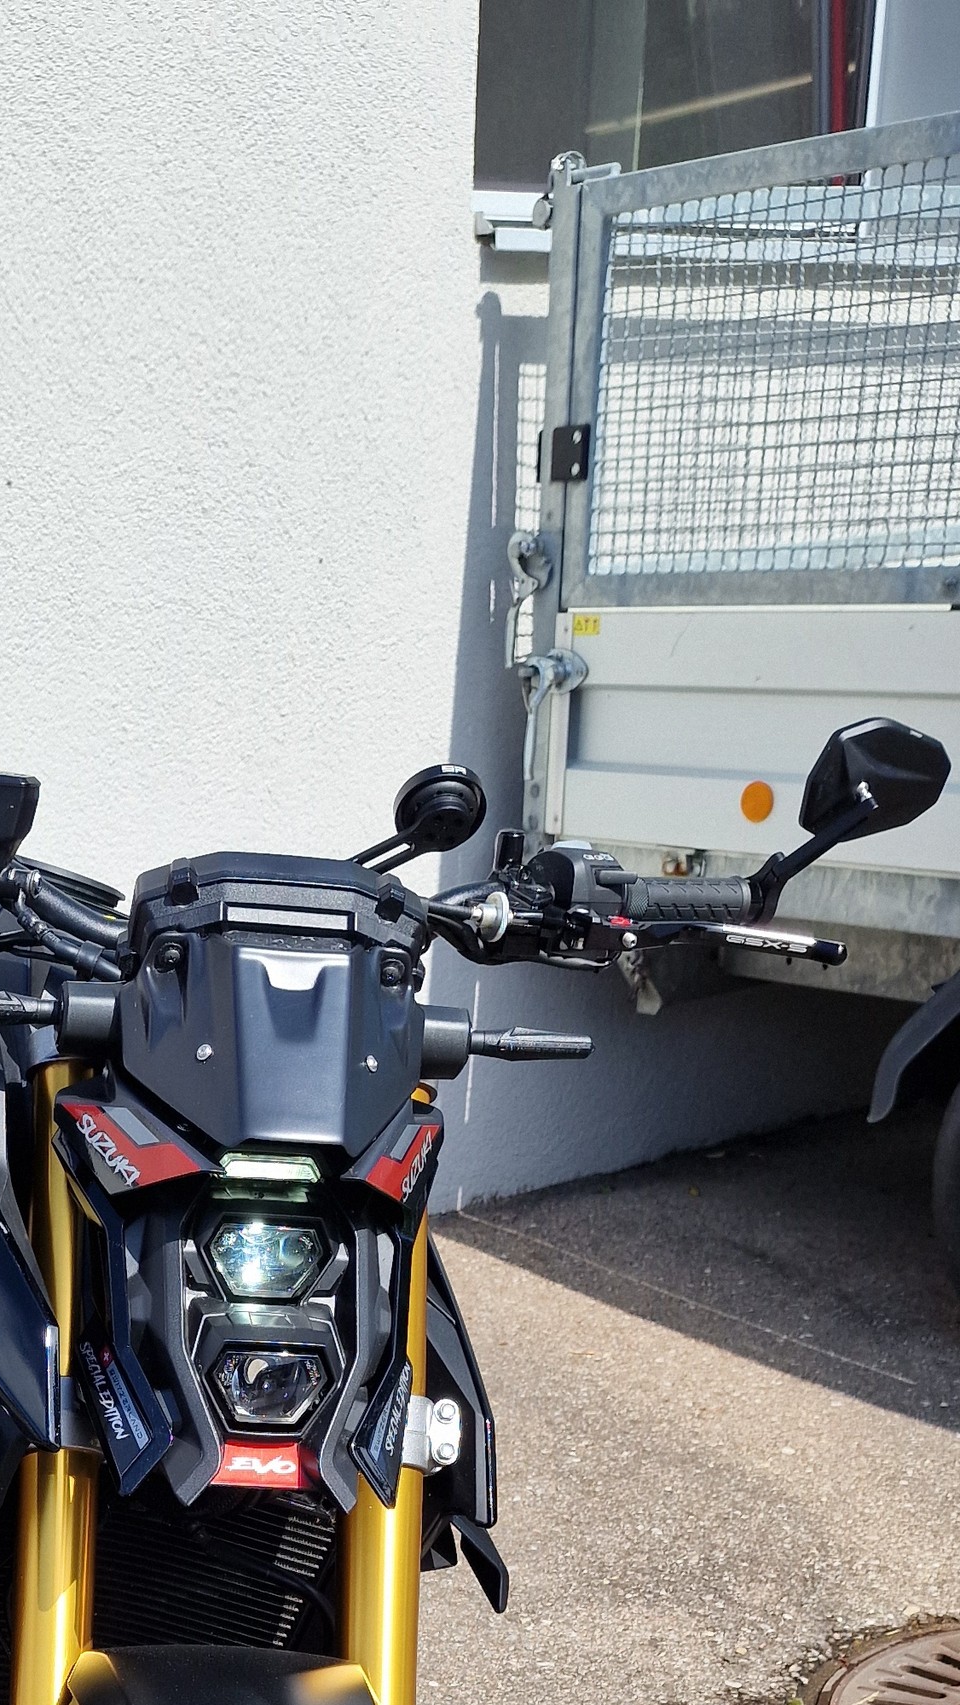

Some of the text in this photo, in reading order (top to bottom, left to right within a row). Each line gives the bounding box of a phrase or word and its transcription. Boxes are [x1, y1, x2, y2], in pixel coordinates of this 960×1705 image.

[725, 934, 808, 954] GSX-S
[76, 1113, 141, 1187] SUZUKI
[402, 1130, 432, 1203] SUZUKI
[80, 1341, 130, 1440] SPECIAL EDITION
[109, 1369, 144, 1439] SWITZERLAND
[224, 1455, 297, 1475] EVO
